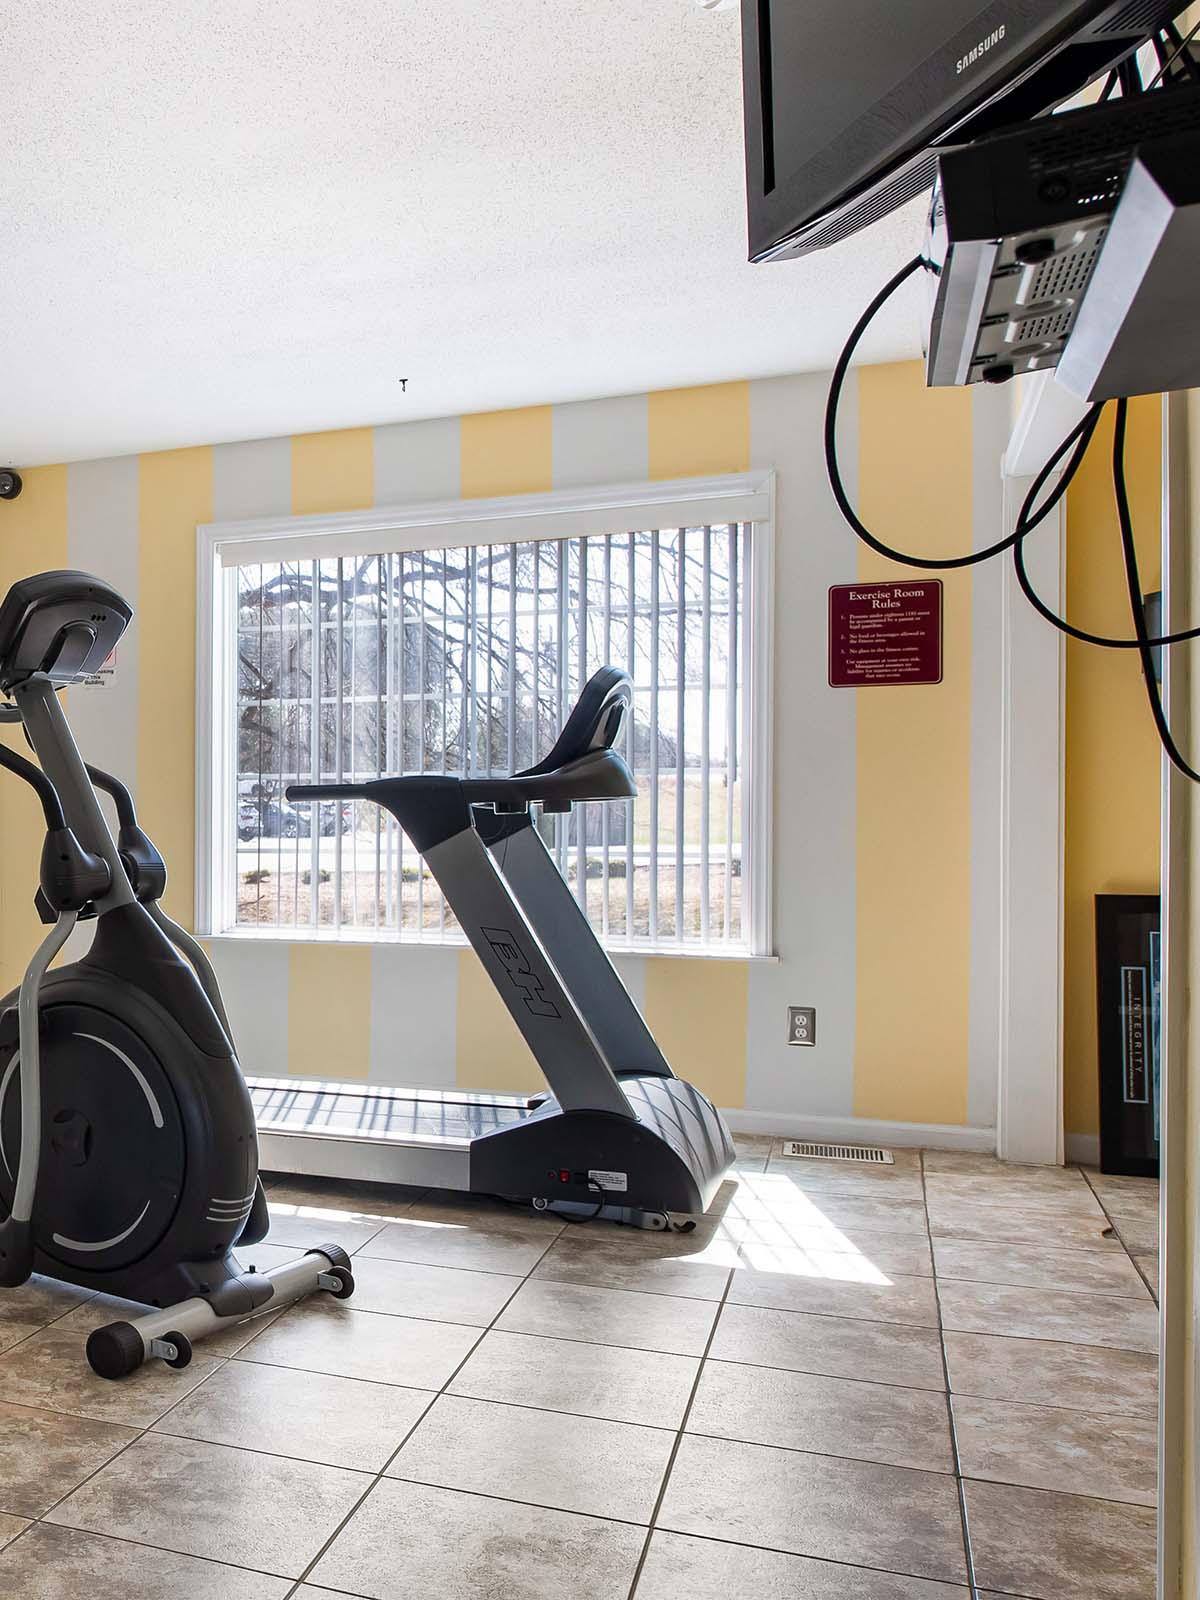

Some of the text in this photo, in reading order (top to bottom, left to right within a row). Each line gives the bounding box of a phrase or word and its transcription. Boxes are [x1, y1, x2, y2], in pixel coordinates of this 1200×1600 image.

[956, 25, 1005, 74] SAMSUNG
[849, 588, 925, 601] Exercise Room
[872, 599, 901, 609] Rules
[480, 926, 562, 1019] BH
[1133, 997, 1143, 1073] INTEGRITY
